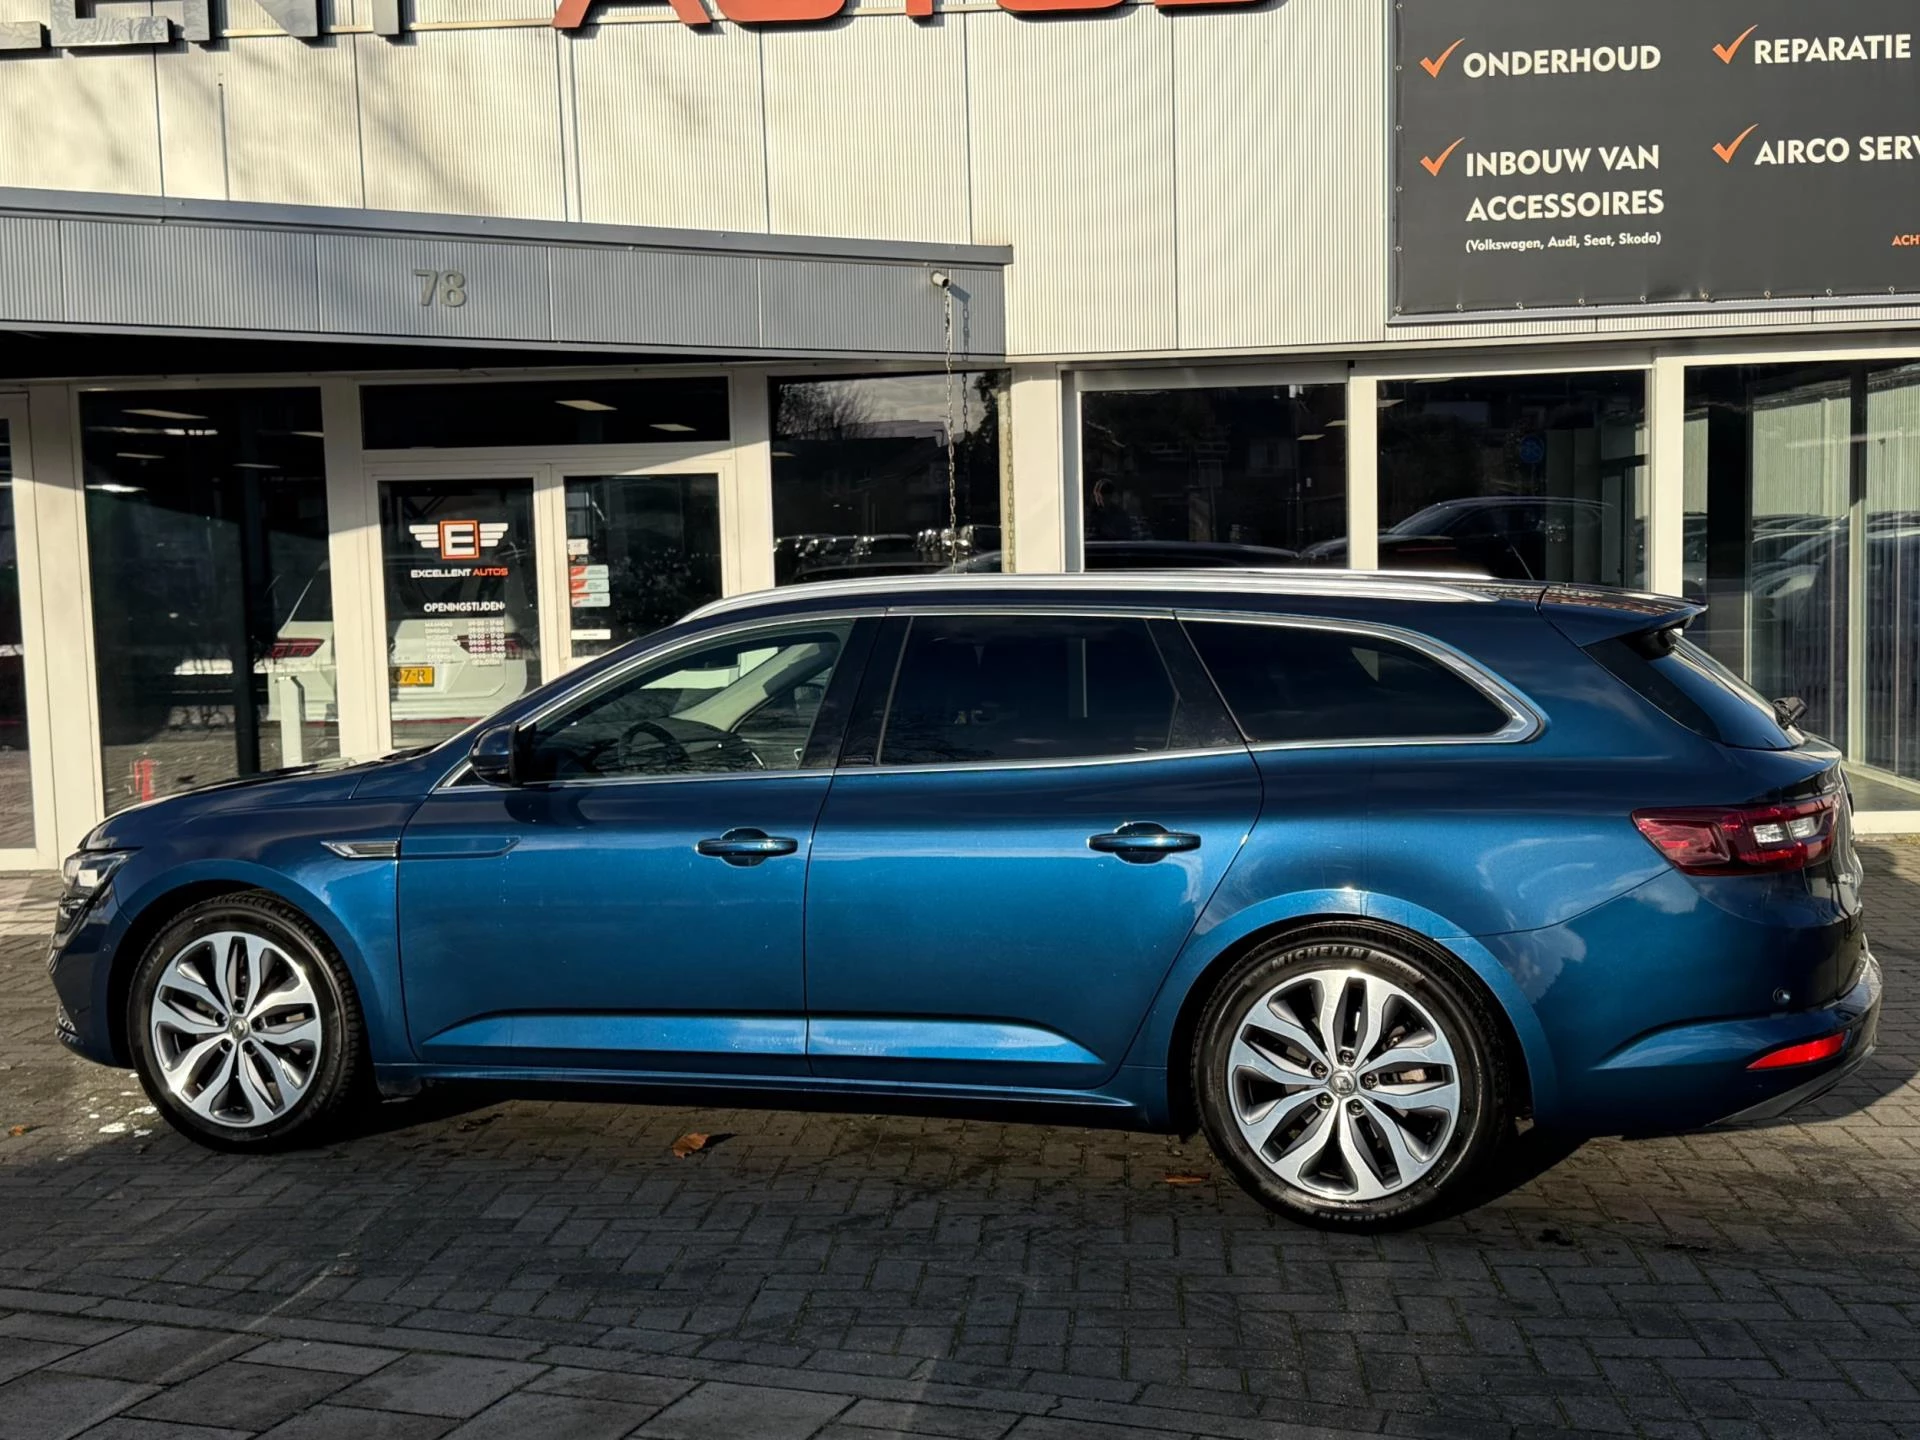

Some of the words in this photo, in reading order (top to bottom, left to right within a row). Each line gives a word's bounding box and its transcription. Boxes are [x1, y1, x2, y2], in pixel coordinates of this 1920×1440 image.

[1463, 45, 1661, 79] ONDERHOUD
[1754, 34, 1911, 64] REPARATIE
[1466, 147, 1592, 177] INBOUW
[1598, 144, 1660, 172] VAN
[1754, 137, 1850, 165] AIRCO
[1465, 189, 1665, 221] ACCESSOIRES
[1465, 239, 1544, 253] (Volkswagen,
[1547, 235, 1580, 249] Audi,
[1583, 233, 1616, 247] Seat,
[1619, 231, 1661, 245] Skoda)
[415, 269, 467, 307] 78
[411, 568, 471, 578] EXCELLENT
[473, 567, 508, 576] AUTOS
[1271, 946, 1365, 969] MICHELIN
